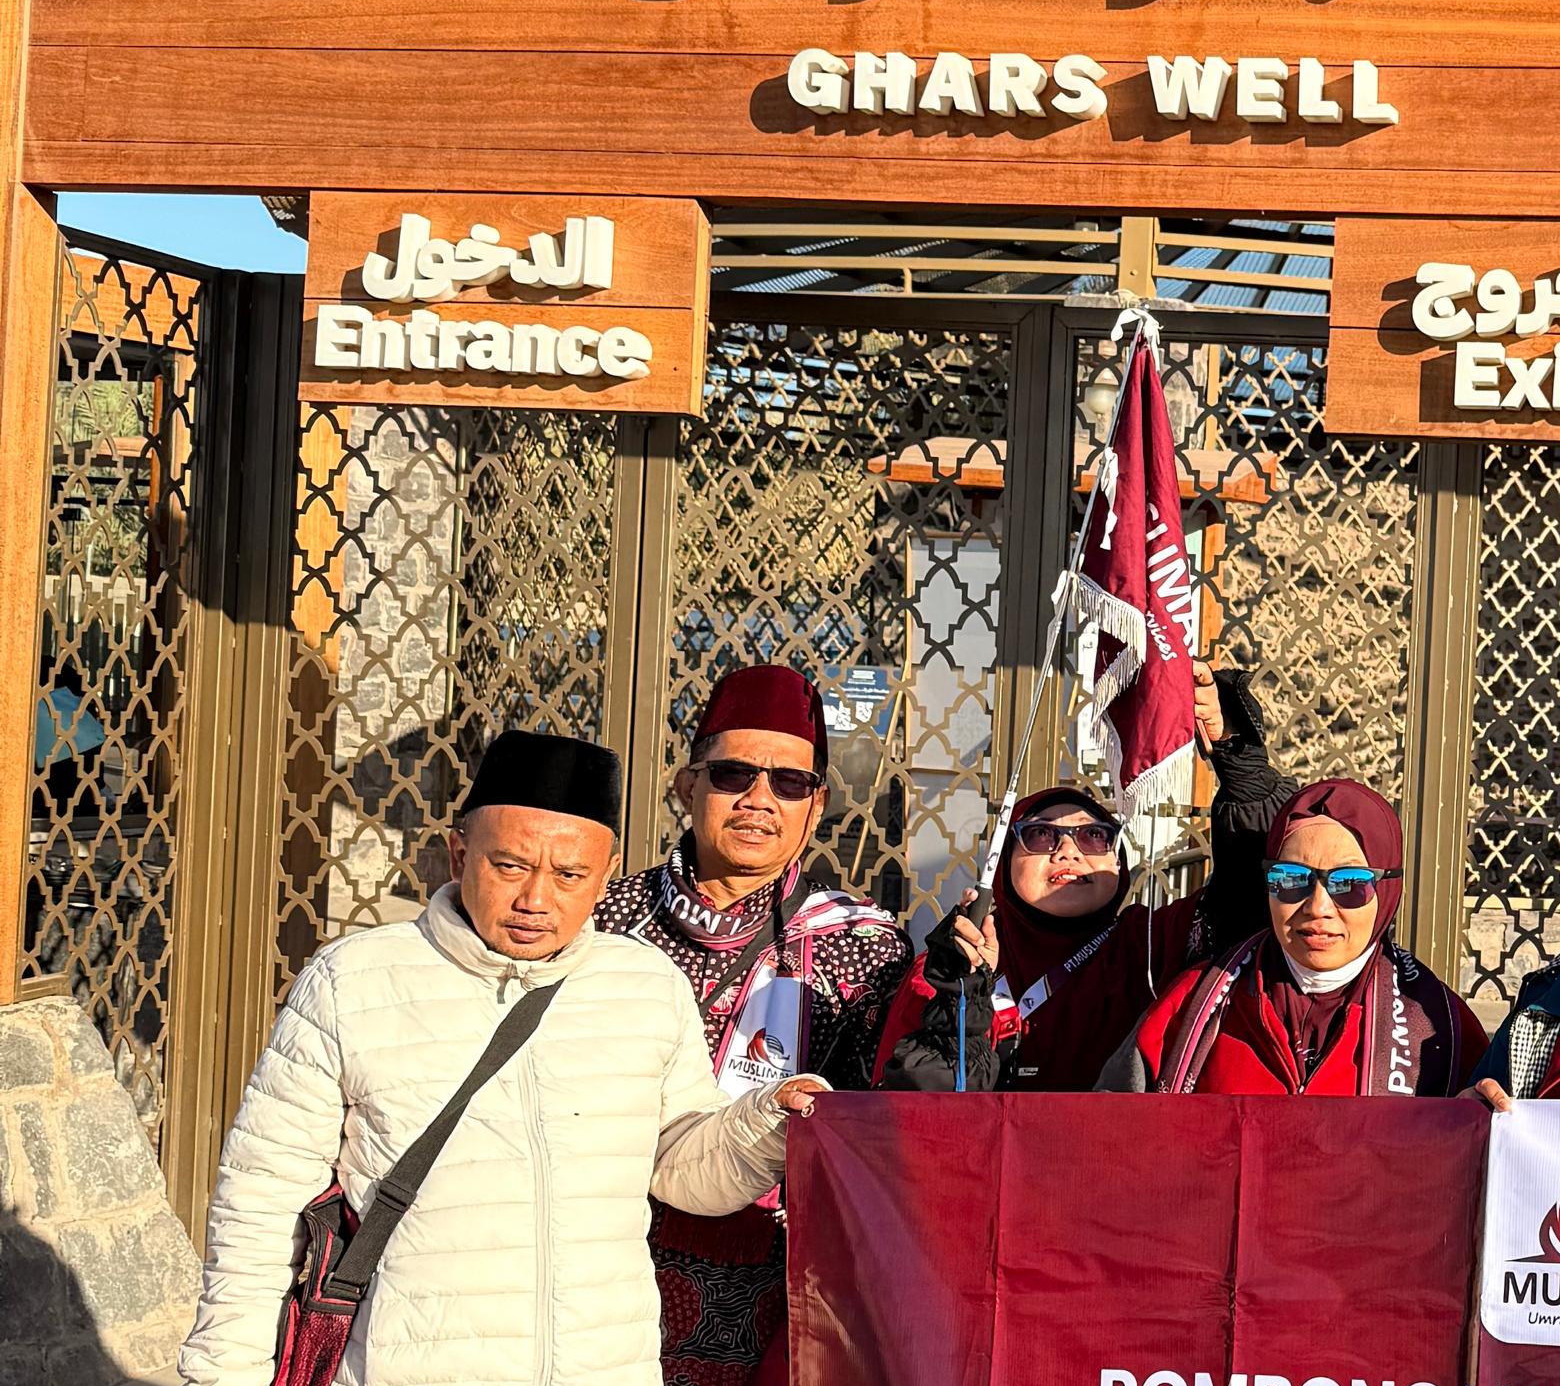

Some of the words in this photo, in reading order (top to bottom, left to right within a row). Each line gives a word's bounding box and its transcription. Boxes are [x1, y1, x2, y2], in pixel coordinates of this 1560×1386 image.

[787, 47, 1108, 120] GHARS
[1148, 55, 1399, 125] WELL
[362, 213, 614, 303] الدخول
[315, 305, 652, 379] Entrance
